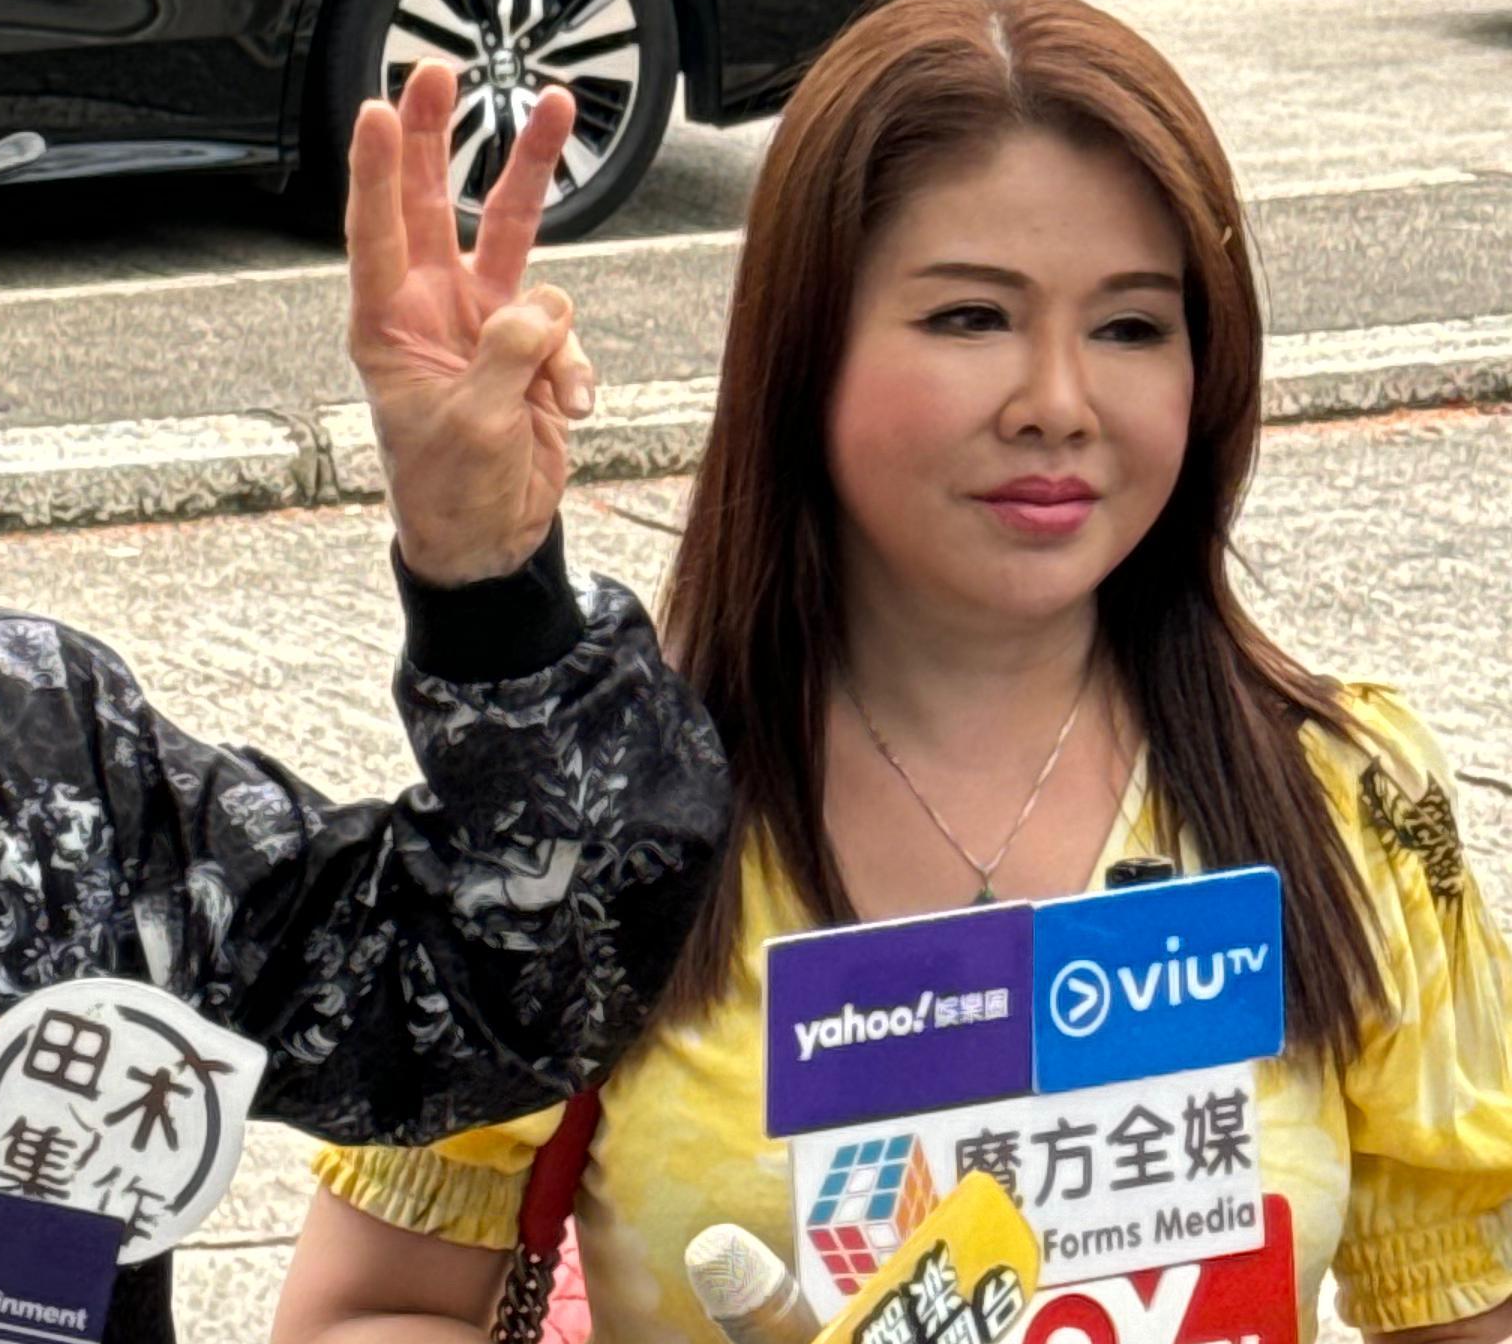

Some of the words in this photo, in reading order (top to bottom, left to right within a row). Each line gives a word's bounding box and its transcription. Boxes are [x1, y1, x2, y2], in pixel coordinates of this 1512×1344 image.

[794, 991, 934, 1061] yahoo!
[1042, 1221, 1143, 1263] Forms
[1153, 1194, 1256, 1244] Media
